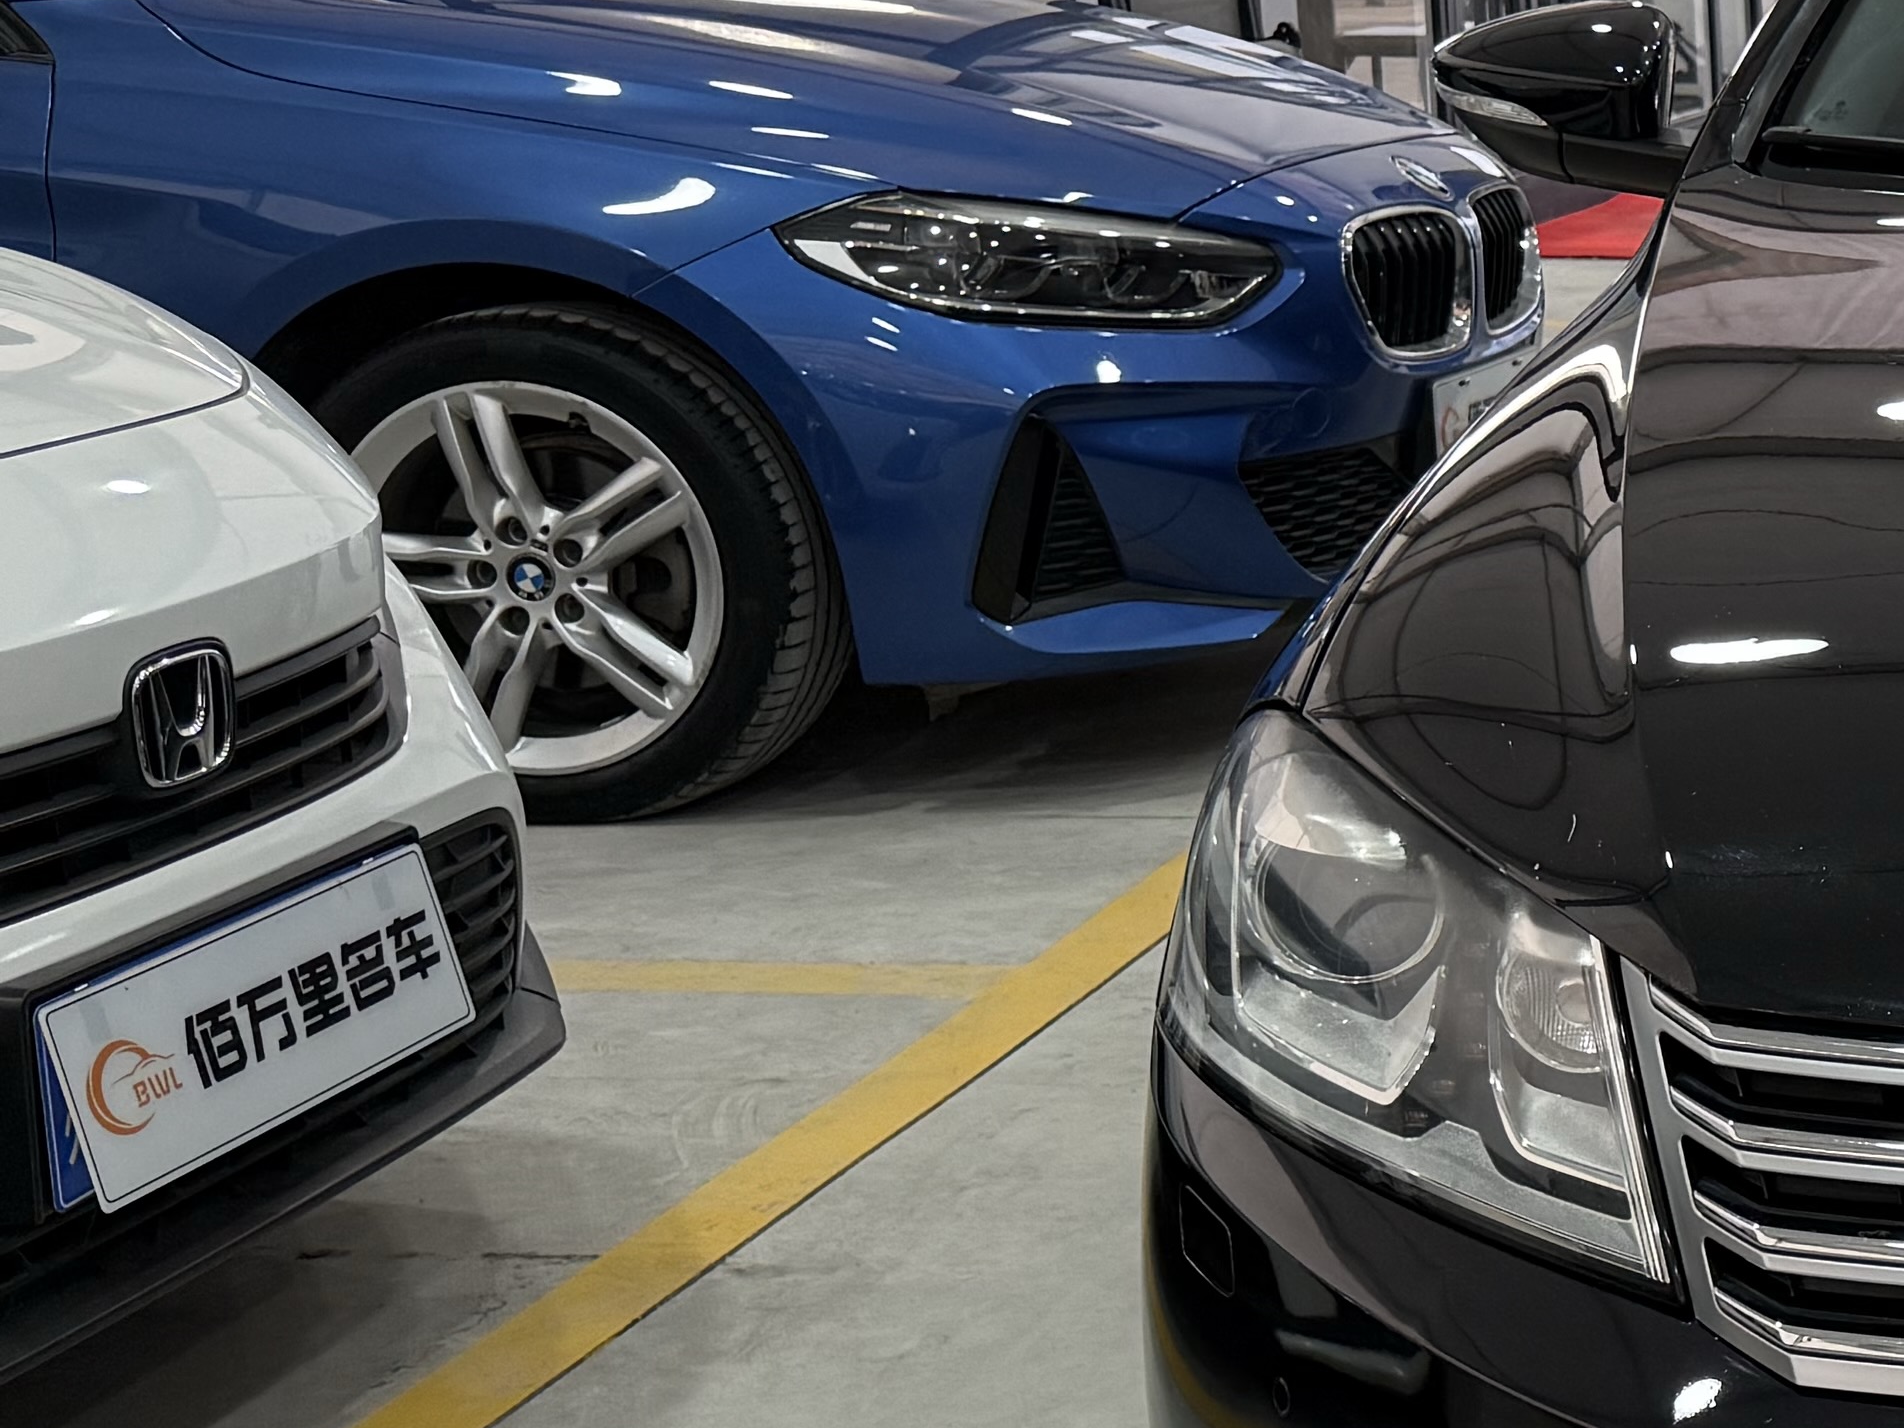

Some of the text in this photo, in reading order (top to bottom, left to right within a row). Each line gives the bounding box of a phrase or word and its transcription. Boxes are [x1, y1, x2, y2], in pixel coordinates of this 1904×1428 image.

[183, 908, 443, 1091] 佰万里名车
